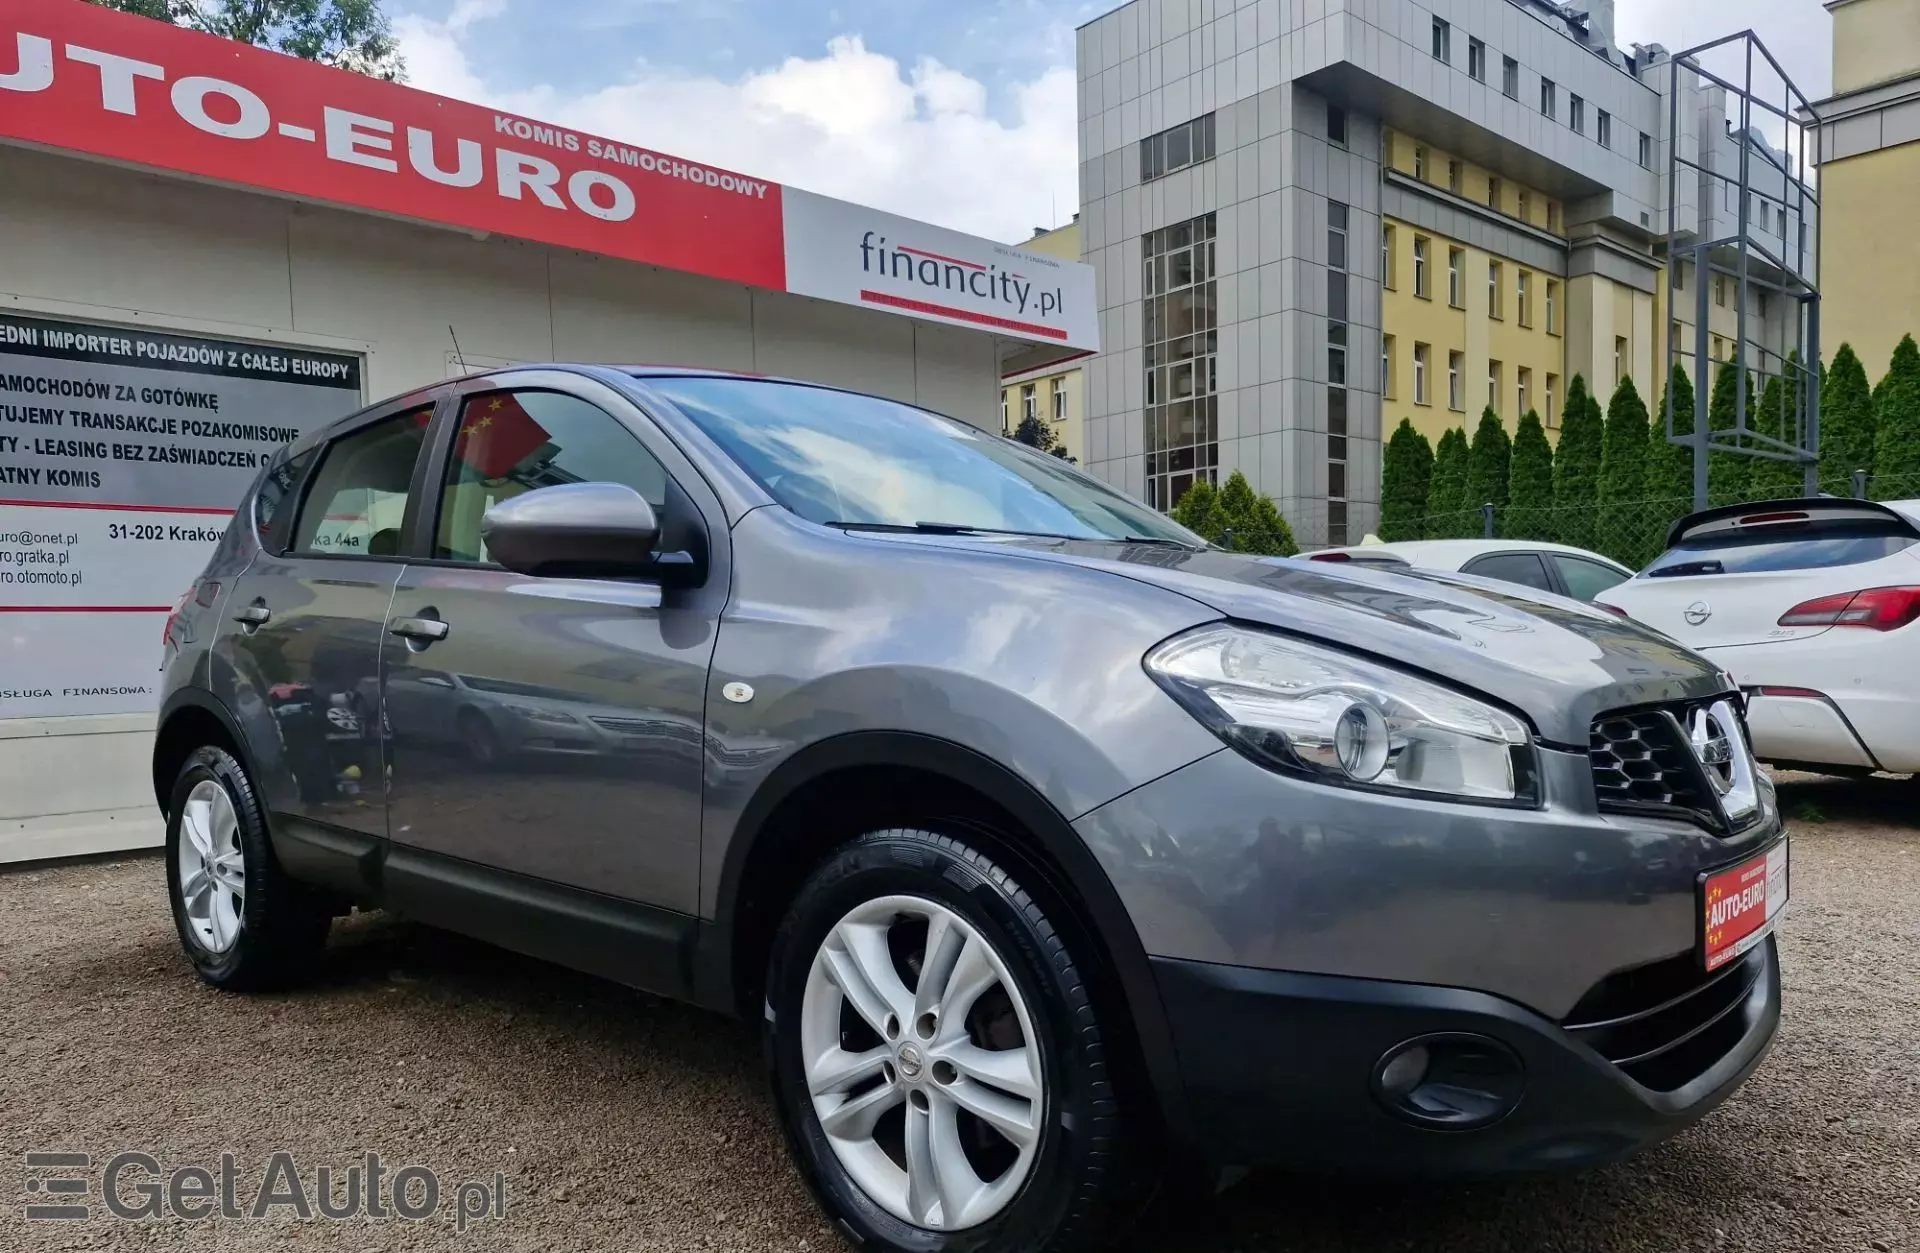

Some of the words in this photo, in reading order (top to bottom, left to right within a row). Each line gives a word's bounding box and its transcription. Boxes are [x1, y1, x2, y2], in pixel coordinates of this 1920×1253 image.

[494, 115, 580, 151] KOMIS
[587, 139, 767, 199] SAMOCHODOWY
[860, 231, 1062, 316] financity.pl
[43, 330, 132, 356] IMPORTER
[136, 340, 223, 367] POJAZDÓW
[227, 352, 237, 367] Z
[241, 352, 288, 373] CAŁEJ
[292, 358, 349, 380] EUROPY
[115, 385, 136, 402] ZA
[141, 387, 218, 414] GOTÓWKĘ
[69, 411, 177, 435] TRANSAKCJE
[182, 420, 299, 443] POZAKOMISOWE
[35, 438, 107, 459] LEASING
[112, 443, 144, 461] BEZ
[149, 444, 256, 468] ZAŚWIADCZEŃ
[47, 468, 101, 488] KOMIS
[108, 524, 164, 541] 31-202
[0, 689, 53, 698] SŁUGA
[63, 686, 153, 697] FINANSOWA:
[1711, 880, 1764, 928] AUTO-EURO
